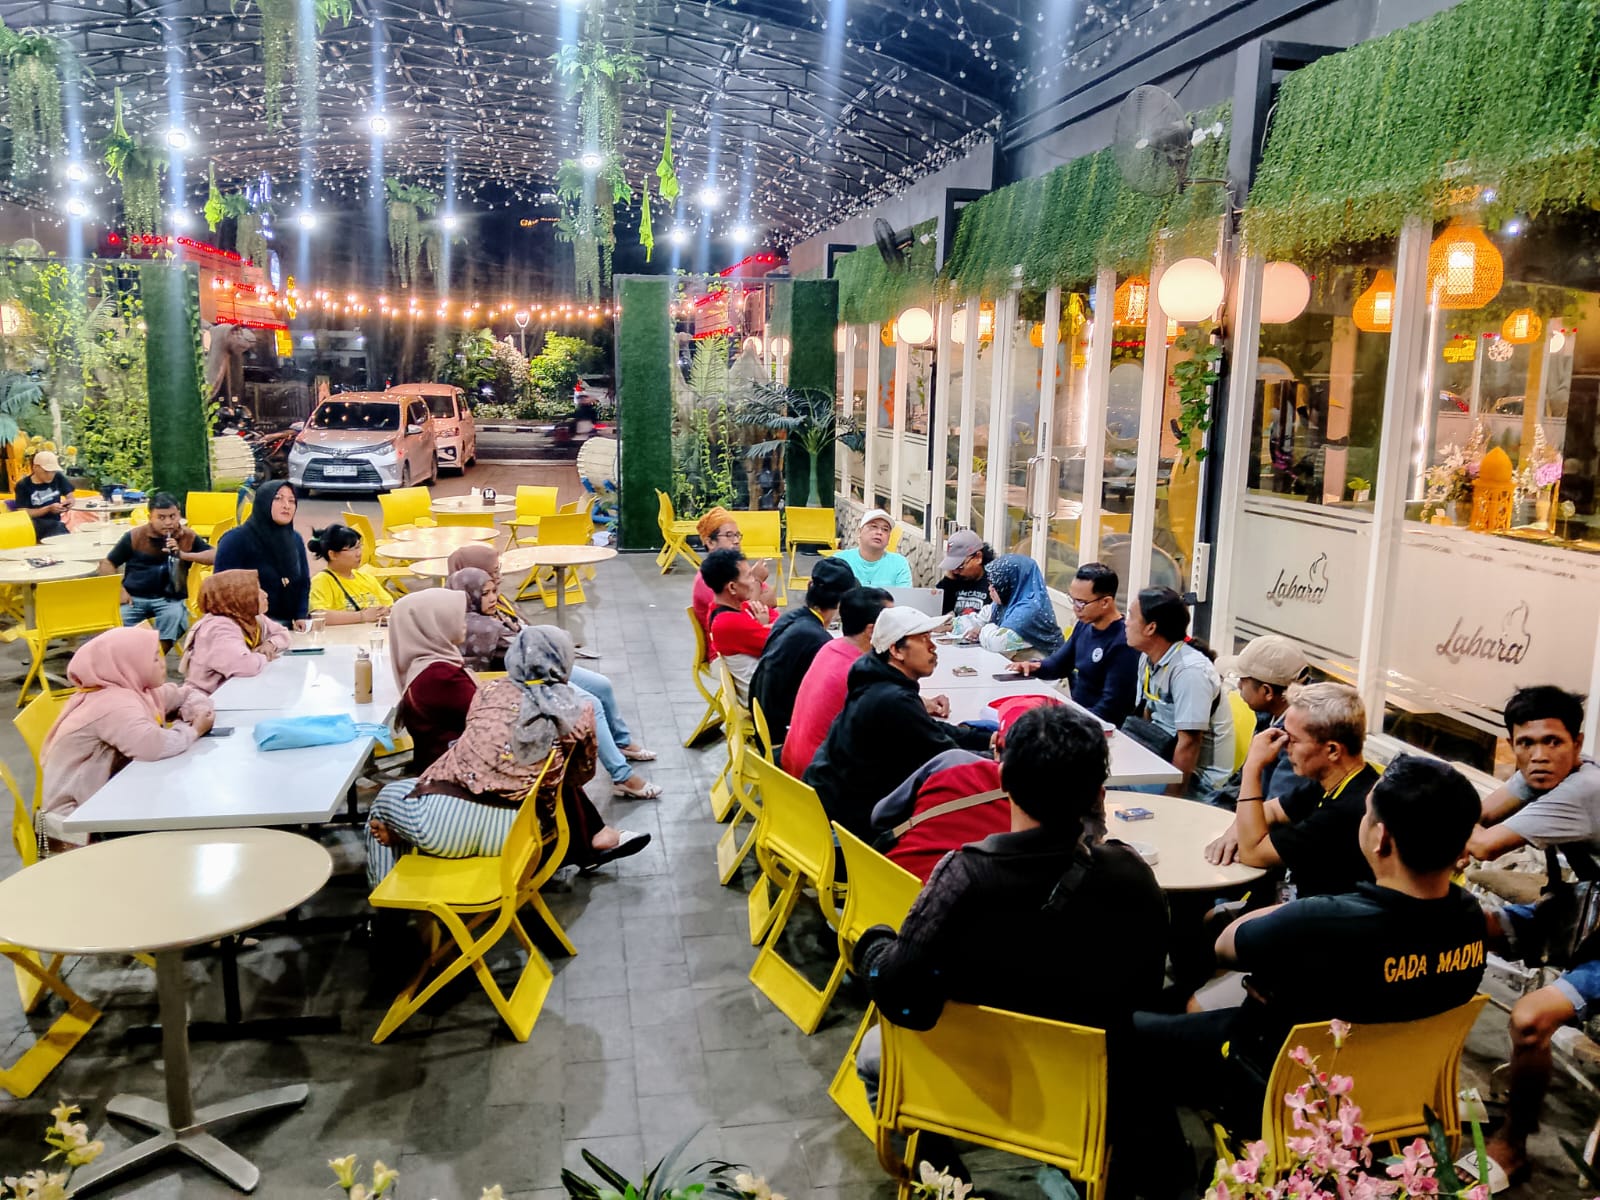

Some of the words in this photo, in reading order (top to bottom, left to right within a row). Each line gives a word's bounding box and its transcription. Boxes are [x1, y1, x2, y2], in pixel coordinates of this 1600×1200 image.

[1266, 566, 1328, 607] Labara
[1436, 613, 1531, 665] Labara
[1384, 954, 1427, 983] GADA
[1436, 940, 1483, 974] MADYA
